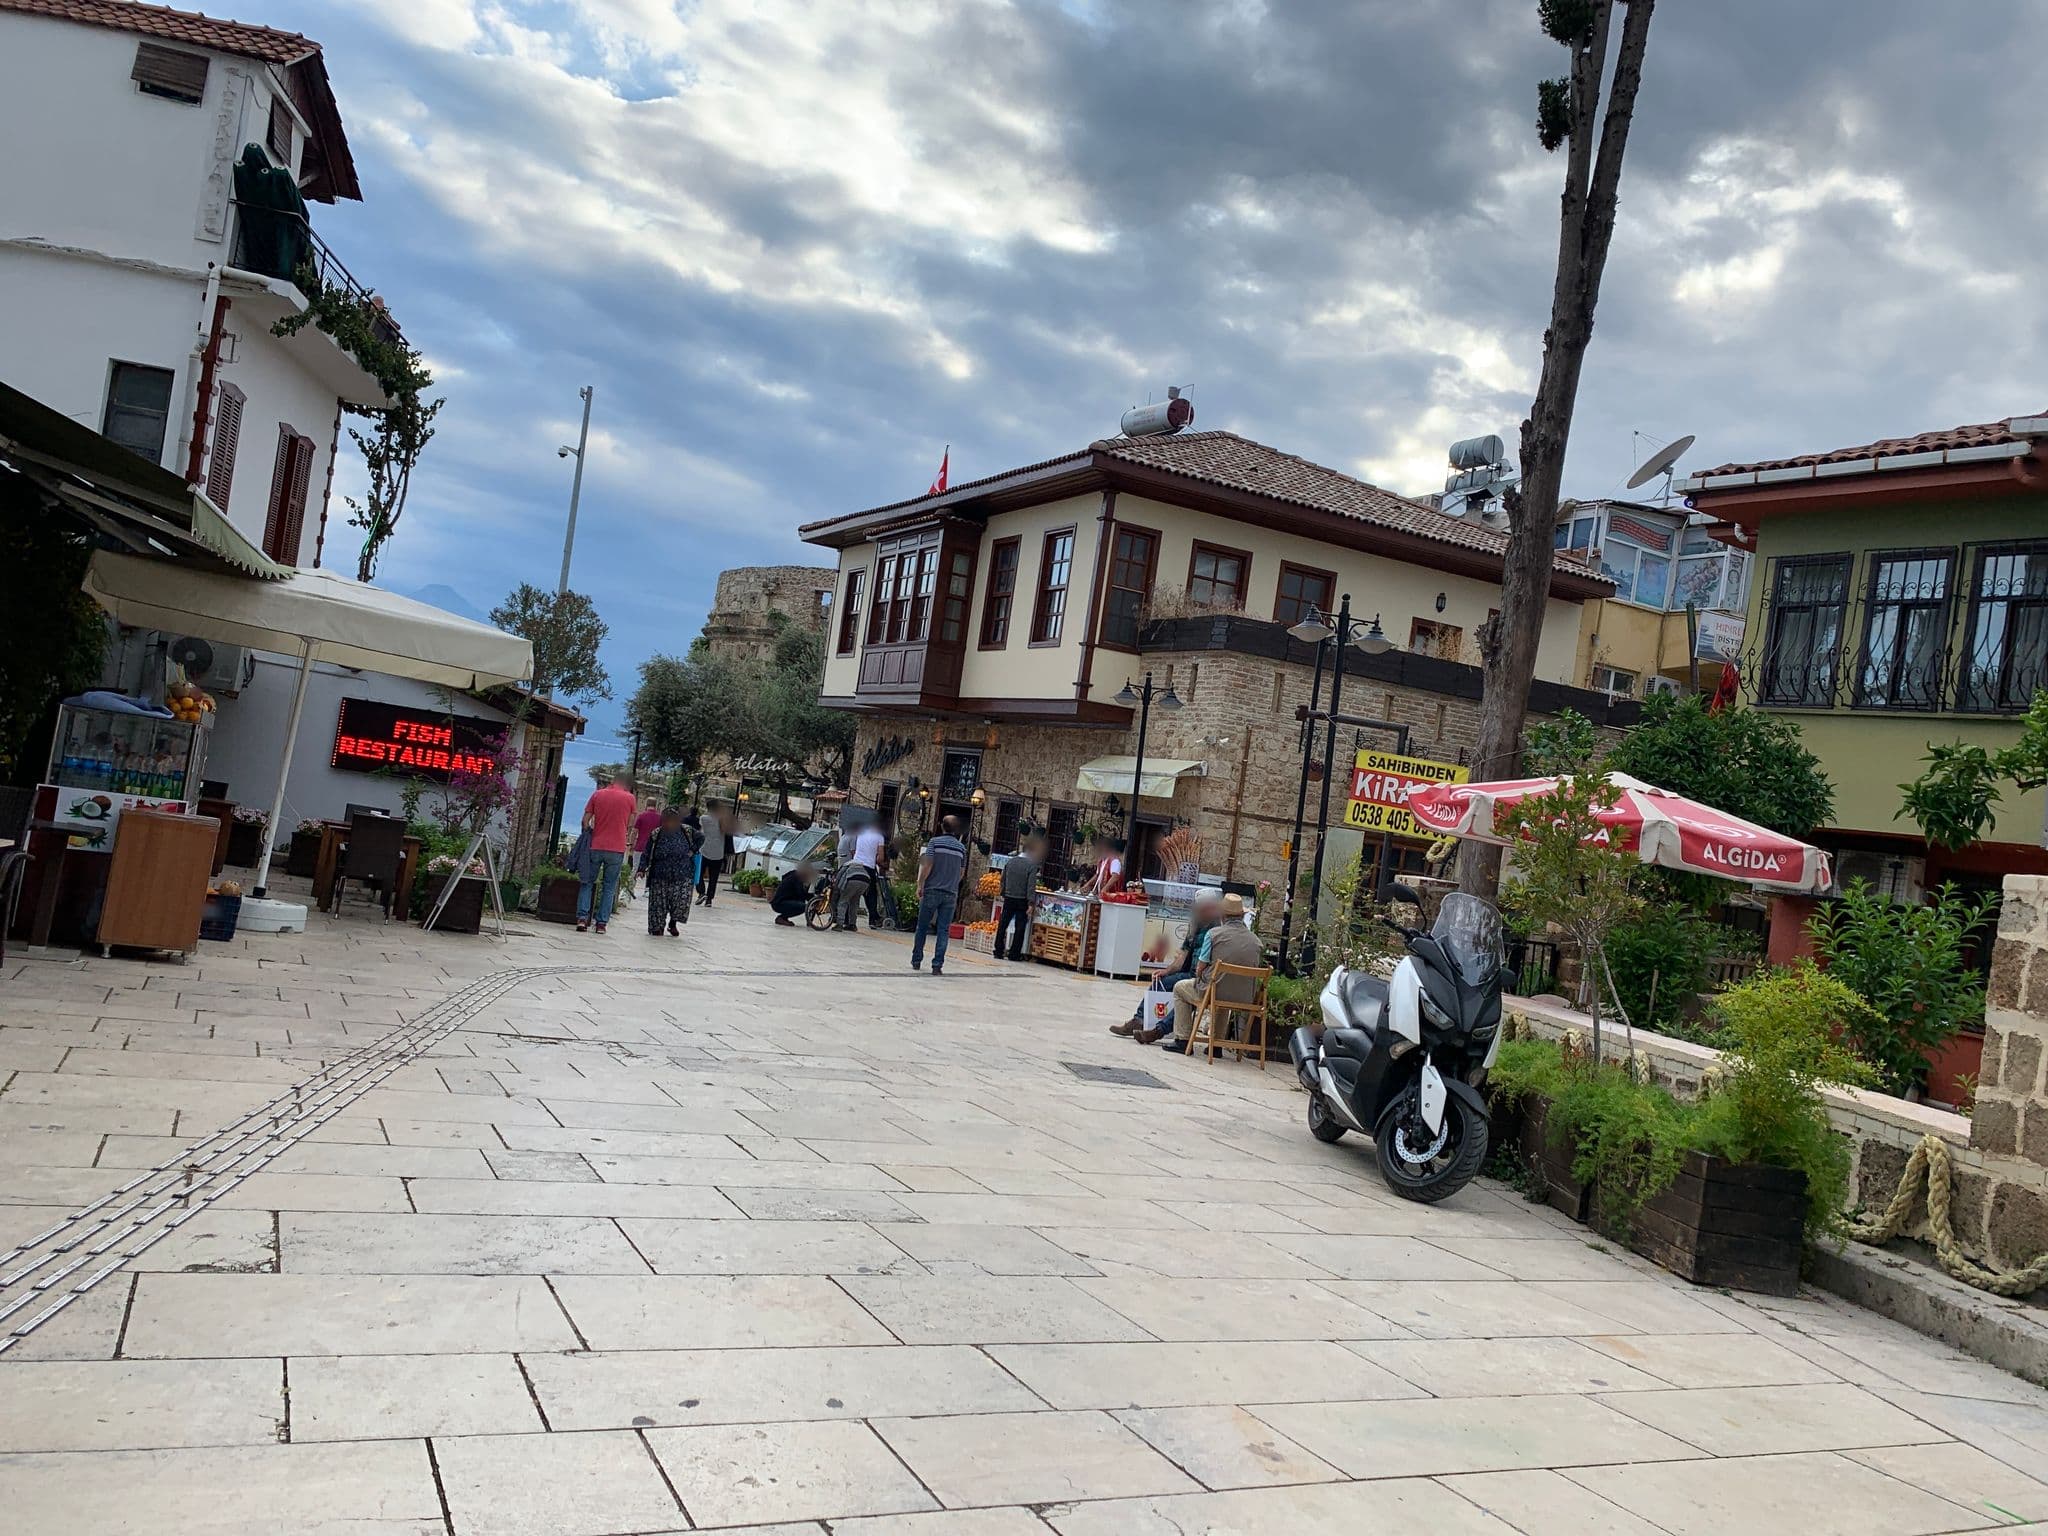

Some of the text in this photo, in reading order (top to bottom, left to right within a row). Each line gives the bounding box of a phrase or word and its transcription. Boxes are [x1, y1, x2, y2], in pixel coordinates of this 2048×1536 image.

[393, 720, 452, 747] FISH
[338, 735, 496, 778] RESTAURANT
[734, 752, 792, 772] telatur
[1352, 802, 1383, 827] 0538
[1386, 808, 1410, 832] 405
